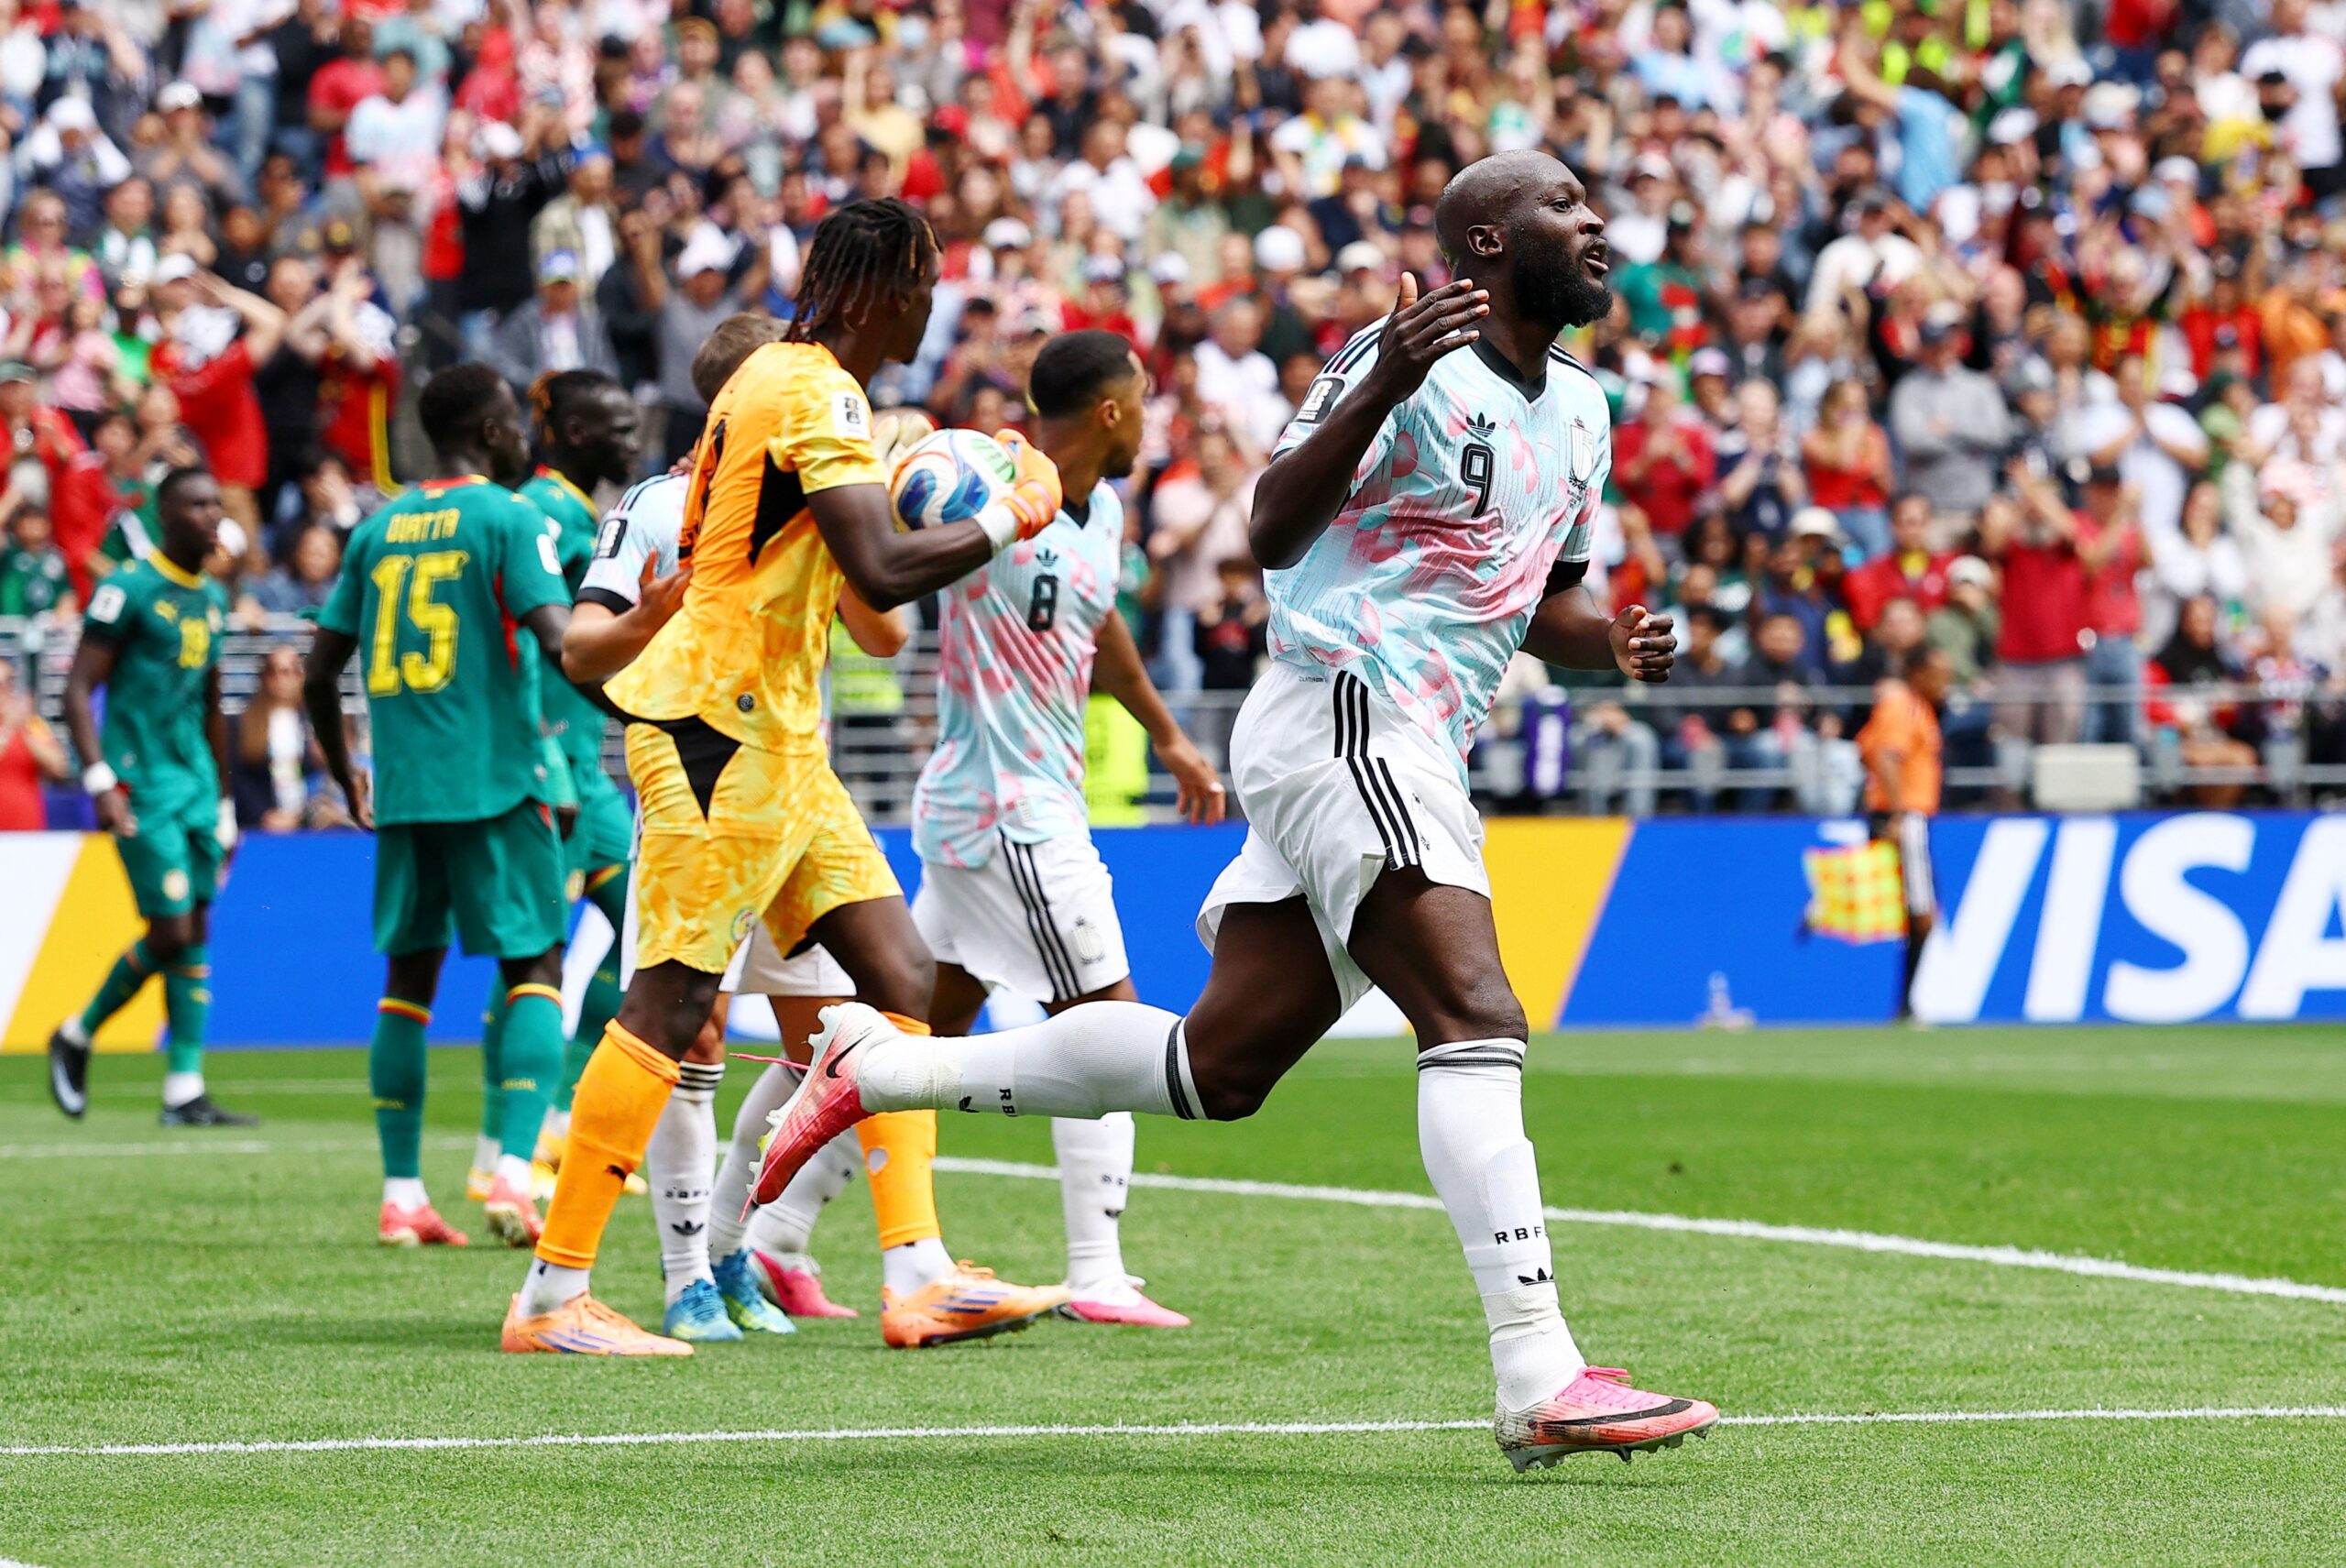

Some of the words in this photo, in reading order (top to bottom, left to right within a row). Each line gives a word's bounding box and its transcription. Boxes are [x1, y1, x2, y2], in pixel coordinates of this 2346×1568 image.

[1461, 443, 1494, 520] 9
[367, 550, 470, 697] 15
[1027, 574, 1058, 631] 8
[999, 1088, 1019, 1117] RB
